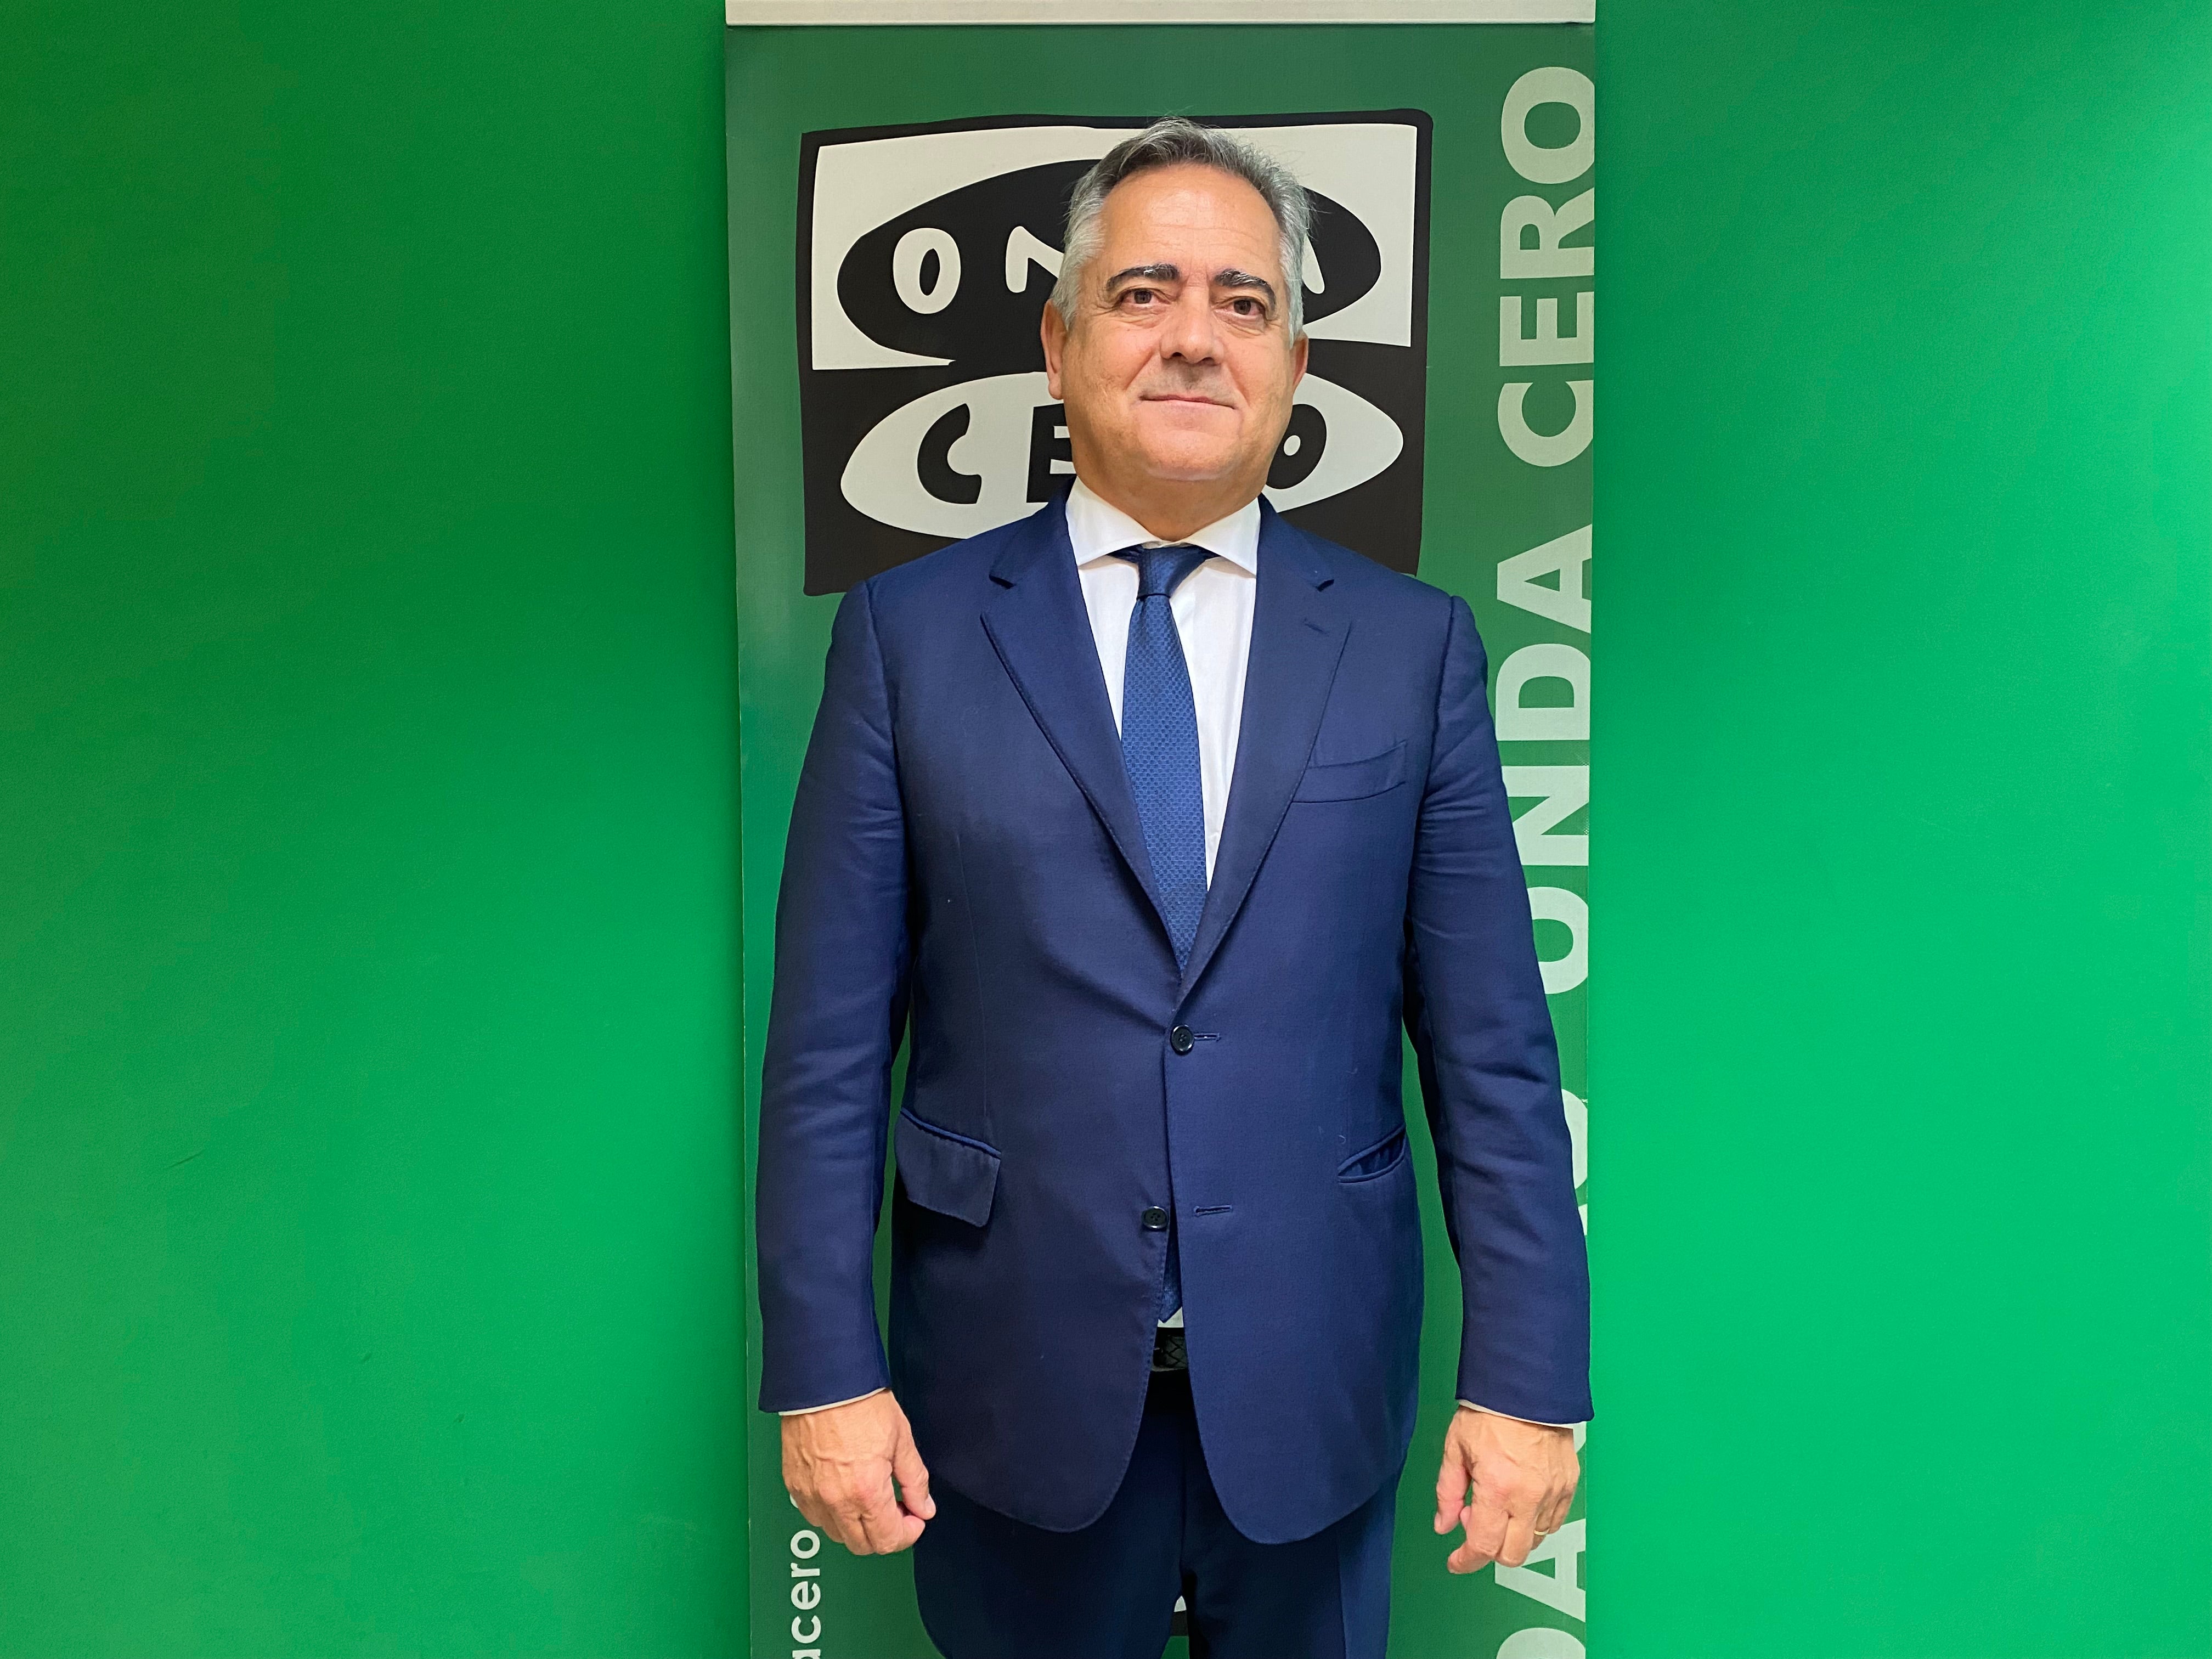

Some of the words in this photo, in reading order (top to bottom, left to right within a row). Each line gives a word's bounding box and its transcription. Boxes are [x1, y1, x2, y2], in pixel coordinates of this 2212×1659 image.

[917, 403, 1327, 504] CEO
[1497, 66, 1594, 467] CERO
[1496, 524, 1592, 995] ONDA
